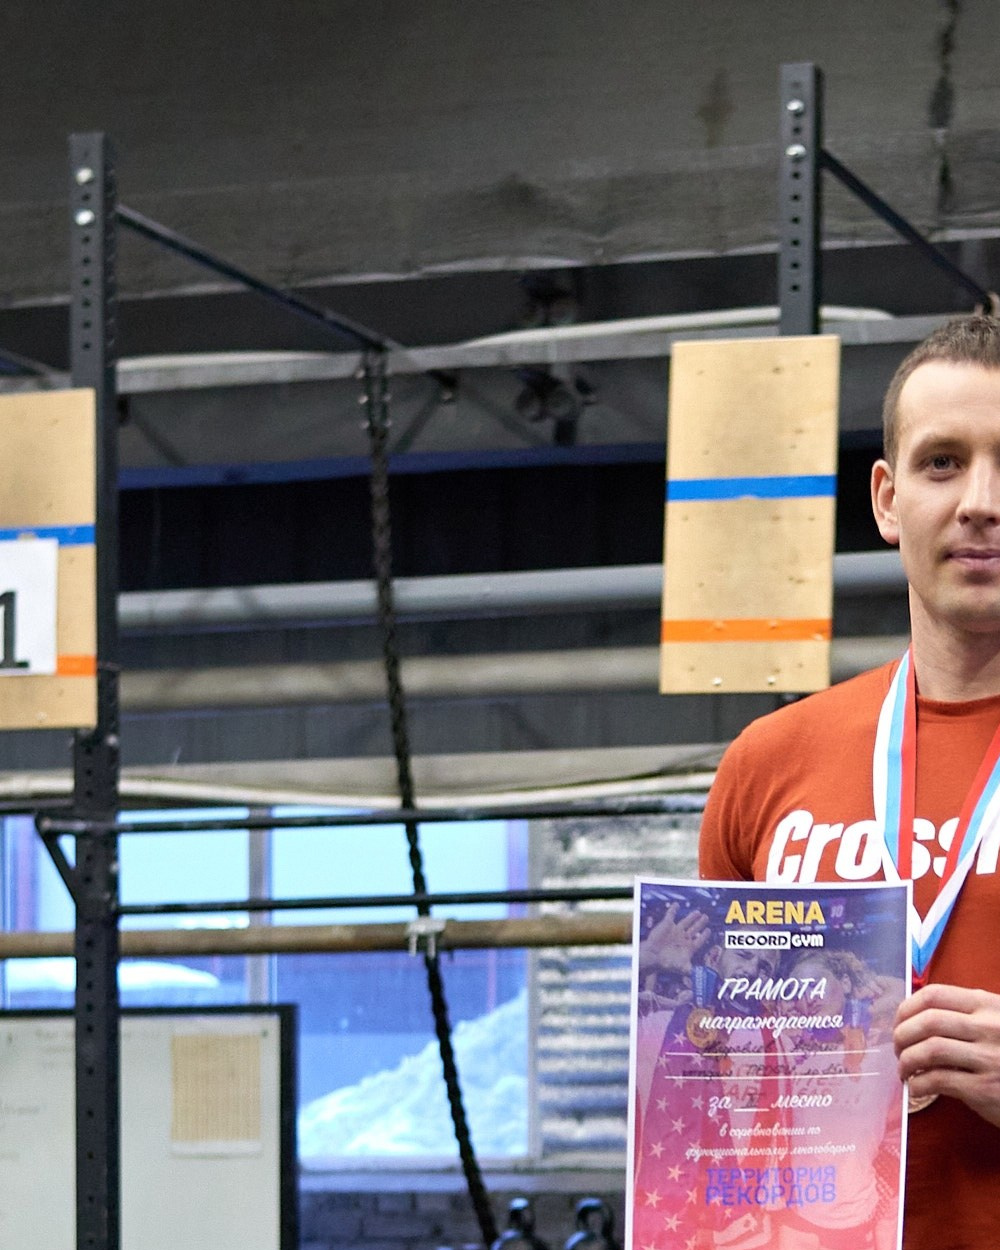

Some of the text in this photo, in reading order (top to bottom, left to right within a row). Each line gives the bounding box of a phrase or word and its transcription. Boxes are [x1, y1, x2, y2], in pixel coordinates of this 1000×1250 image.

[0, 591, 29, 668] 1
[725, 900, 826, 925] ARENA
[727, 935, 788, 946] RECORD
[717, 977, 827, 1000] ГРАМОТА
[699, 1014, 844, 1038] награждается
[708, 1096, 733, 1117] за
[770, 1094, 832, 1108] место
[719, 1122, 729, 1137] в
[685, 1144, 788, 1162] функциональному
[706, 1165, 836, 1184] ТЕРРИТОРИЯ
[705, 1183, 837, 1207] РЕКОРДОВ
